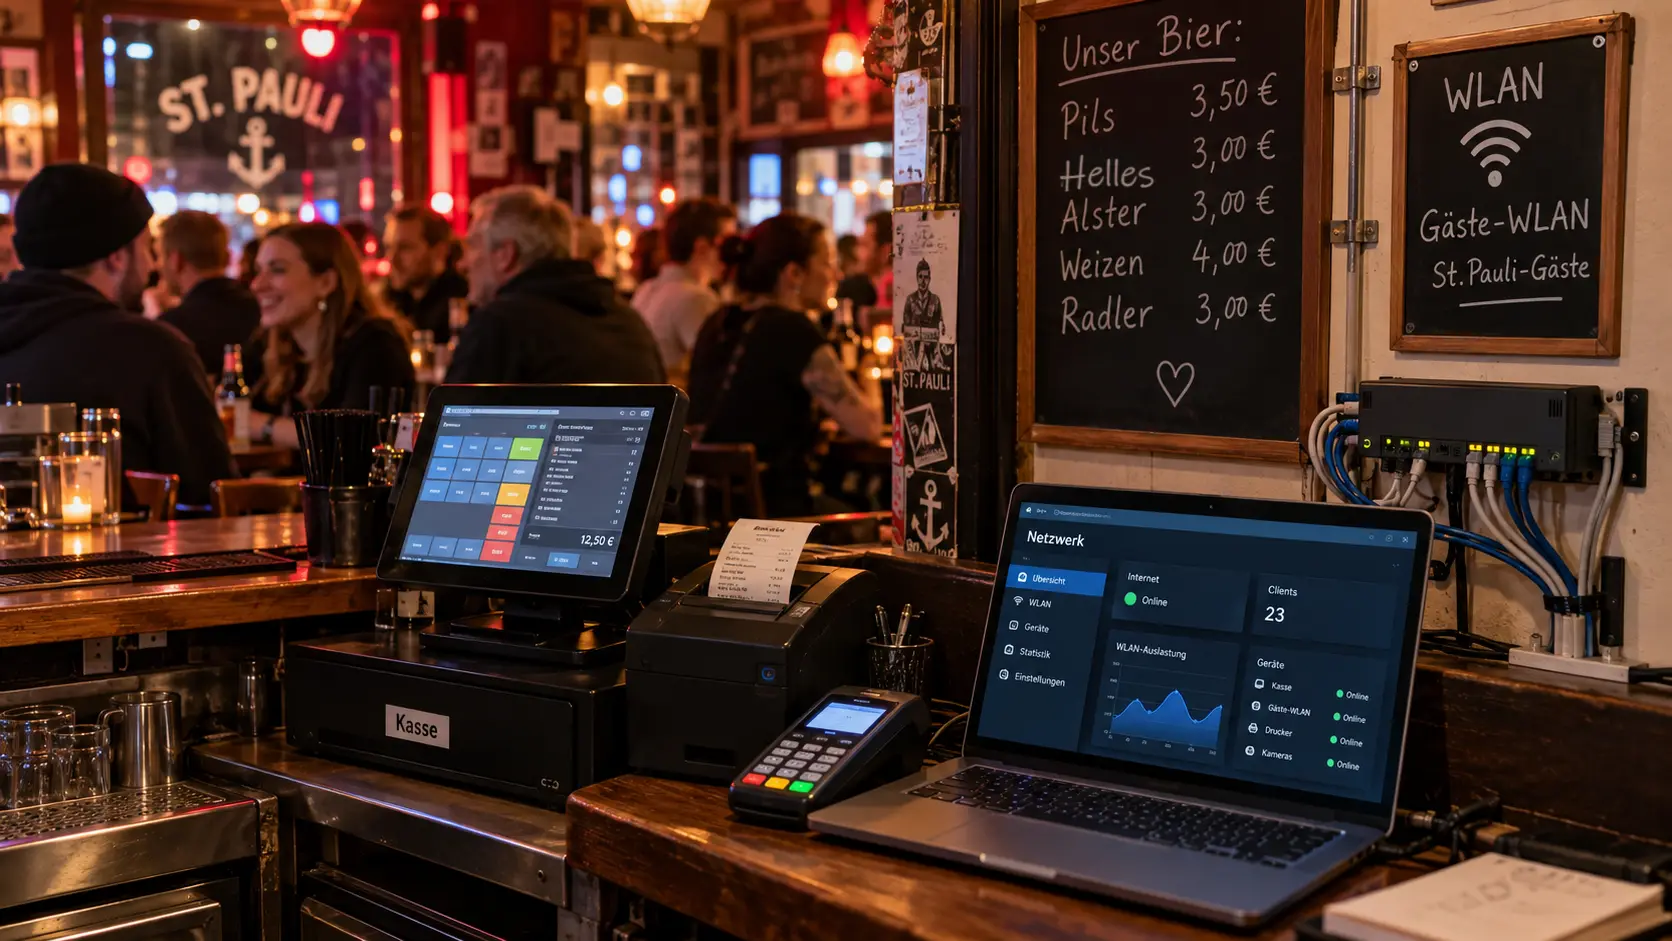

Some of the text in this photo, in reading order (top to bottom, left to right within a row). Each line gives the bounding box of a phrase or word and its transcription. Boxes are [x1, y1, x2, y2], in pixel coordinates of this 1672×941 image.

[1063, 14, 1242, 71] Unser Bier:
[1445, 61, 1543, 114] WLAN
[158, 66, 345, 134] ST. PAULI
[1062, 72, 1277, 141] Pils 3,50 €
[1060, 129, 1275, 193] Helles 3,00 €
[1060, 185, 1274, 235] Alster 3,00 €
[1420, 197, 1589, 243] Gäste-WLAN
[1061, 237, 1275, 282] Weizen 4,00 €
[1062, 292, 1276, 335] Radler 3,00 €
[580, 534, 615, 548] 12,50 €
[1026, 530, 1085, 547] Netzwerk
[1127, 572, 1160, 584] Internet
[1141, 595, 1168, 607] Online
[1267, 585, 1298, 597] Clients
[1029, 598, 1052, 608] WLAN
[1264, 606, 1286, 623] 23
[1019, 647, 1052, 660] Statistik
[1116, 642, 1187, 660] WLAN-Auslastung
[1014, 671, 1066, 688] Einstellungen
[1271, 681, 1370, 702] Kasse Online
[395, 713, 439, 740] Kasse
[1342, 713, 1367, 725] Online
[1264, 726, 1364, 748] Drucker Online
[1261, 748, 1361, 771] Kameras Online
